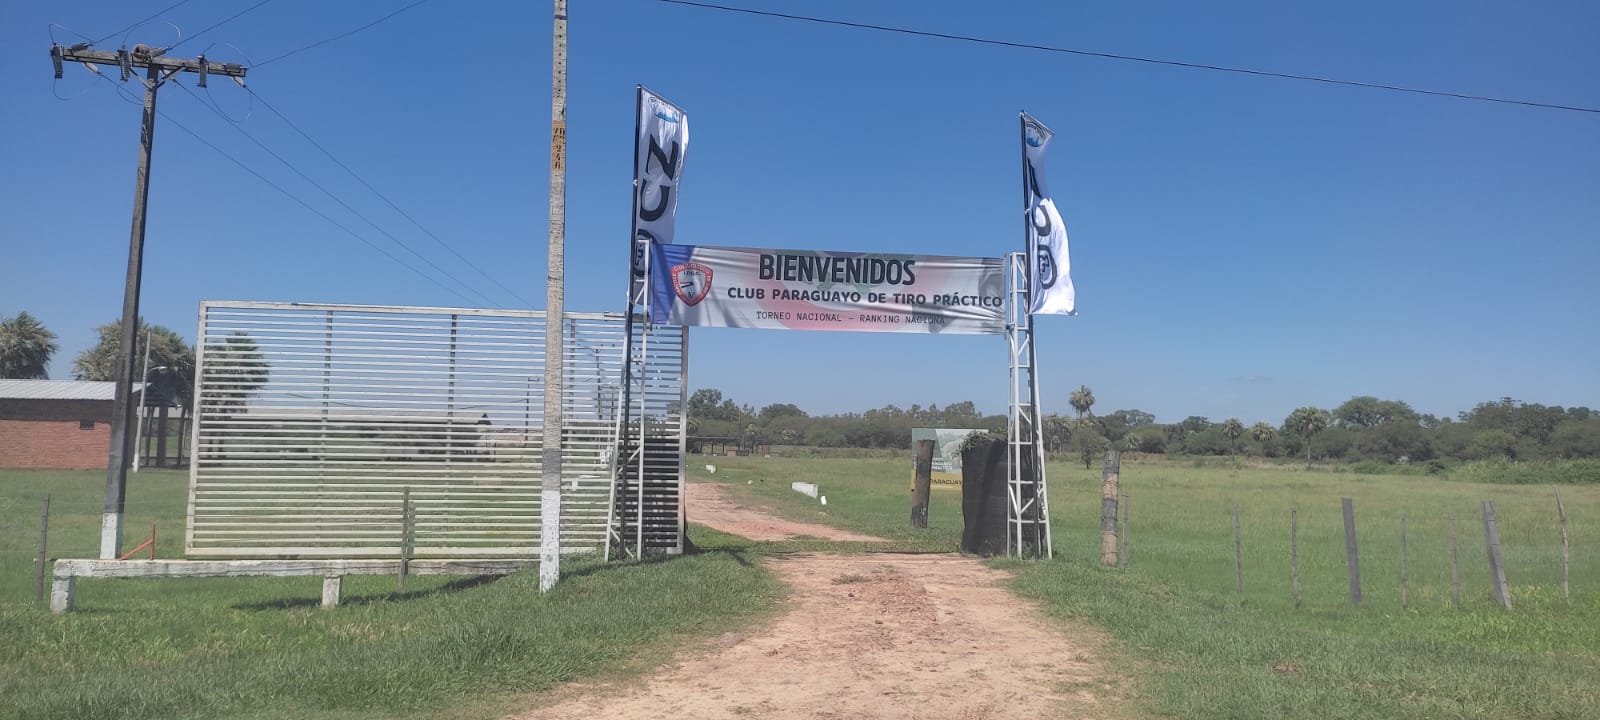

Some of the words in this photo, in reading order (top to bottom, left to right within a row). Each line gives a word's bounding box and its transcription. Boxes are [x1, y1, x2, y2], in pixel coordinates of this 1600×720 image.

[759, 254, 916, 286] BIENVENIDOS
[727, 287, 765, 299] CLUB
[772, 289, 861, 303] PARAGUAYO
[868, 292, 887, 304] DE
[893, 293, 926, 305] TIRO
[933, 291, 1003, 307] PRÁCTICO
[756, 311, 791, 320] TORNEO
[796, 312, 842, 322] NACIONAL
[860, 314, 900, 324] RANKING
